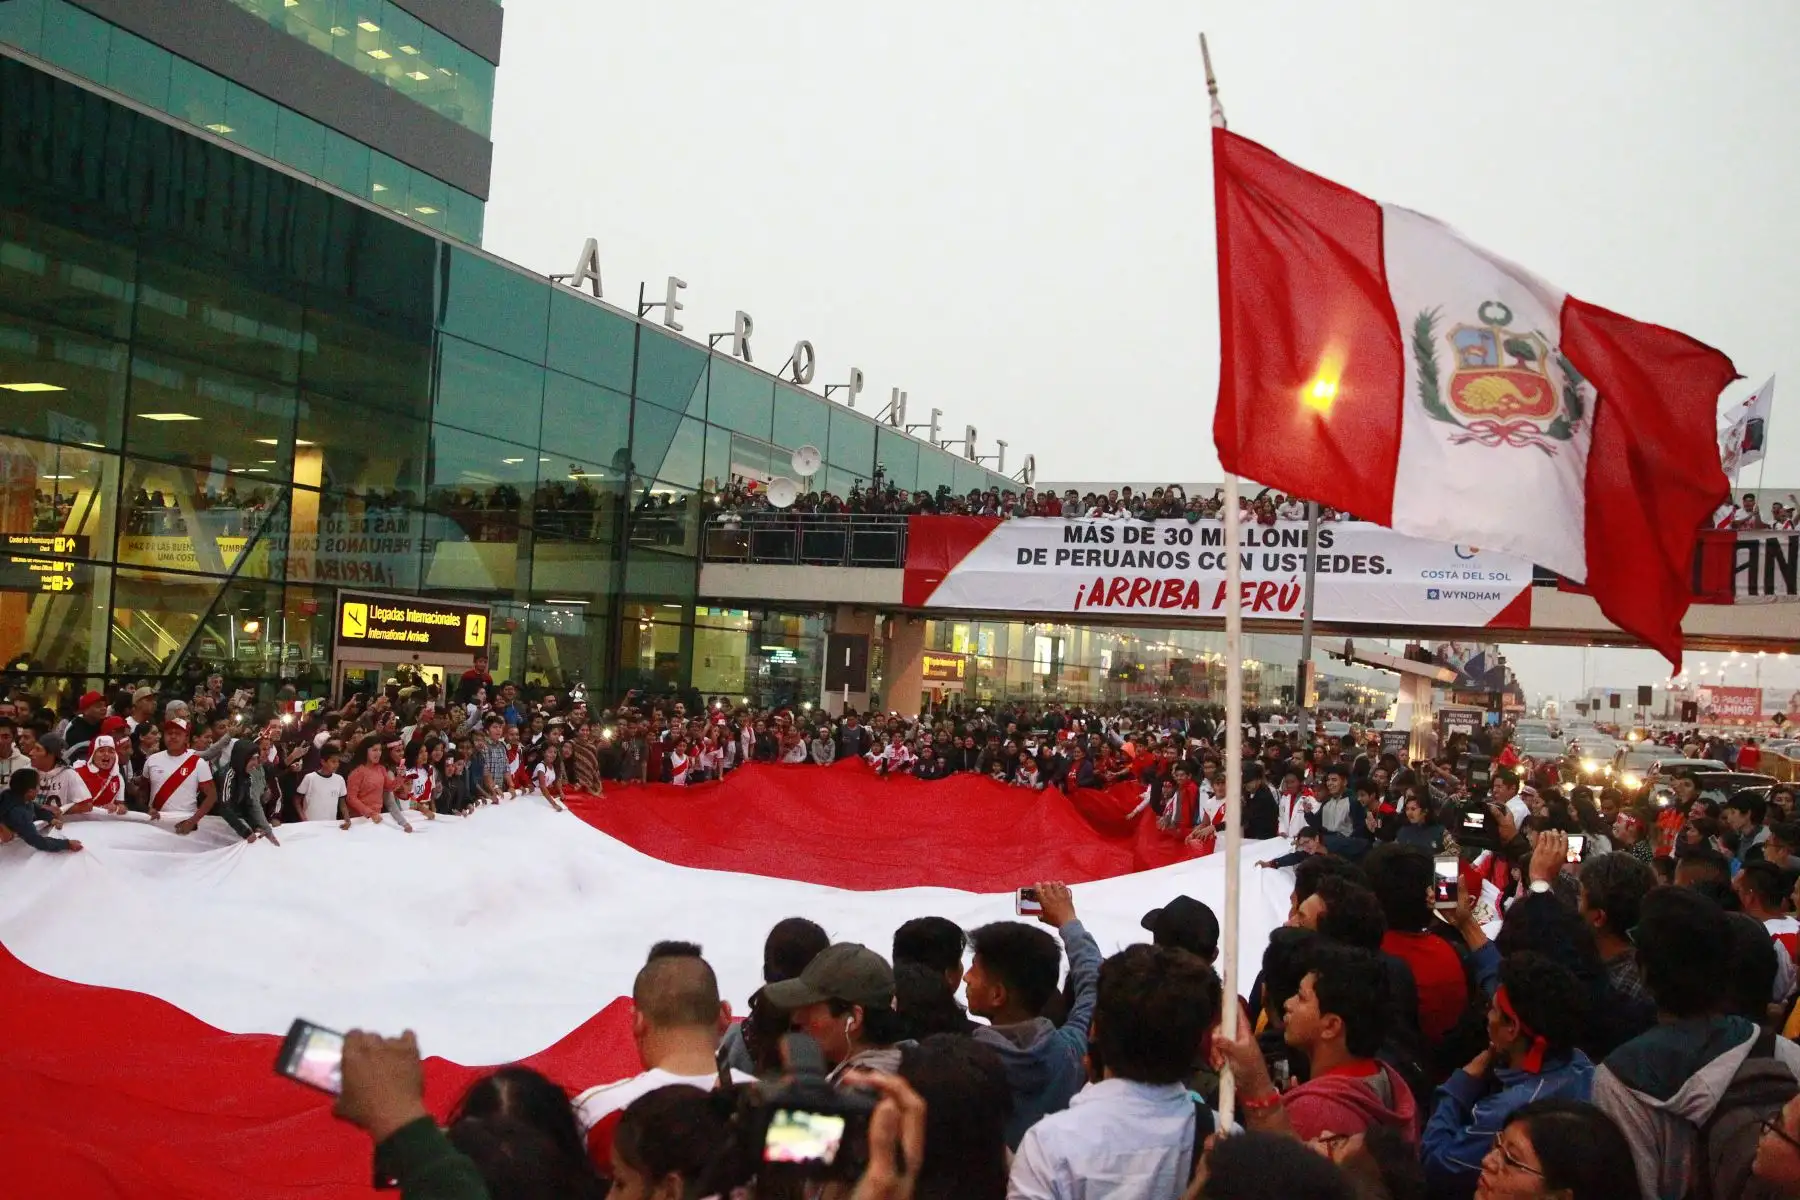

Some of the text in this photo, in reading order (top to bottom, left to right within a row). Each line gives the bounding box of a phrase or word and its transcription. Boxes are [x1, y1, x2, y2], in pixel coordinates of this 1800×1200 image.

[570, 237, 1036, 485] AEROPUERTO
[1064, 524, 1115, 544] MÁS
[1123, 526, 1156, 545] DE
[1164, 527, 1193, 546] 30
[1016, 548, 1047, 566] DE
[1055, 549, 1191, 570] PERUANOS
[1421, 570, 1512, 581] COSTA DEL SOL
[1074, 576, 1200, 611] ¡ARRIBA
[1442, 590, 1501, 600] WYNDHAM
[370, 604, 479, 643] Llegadas Internacionales 4
[368, 627, 430, 643] International Arrivals
